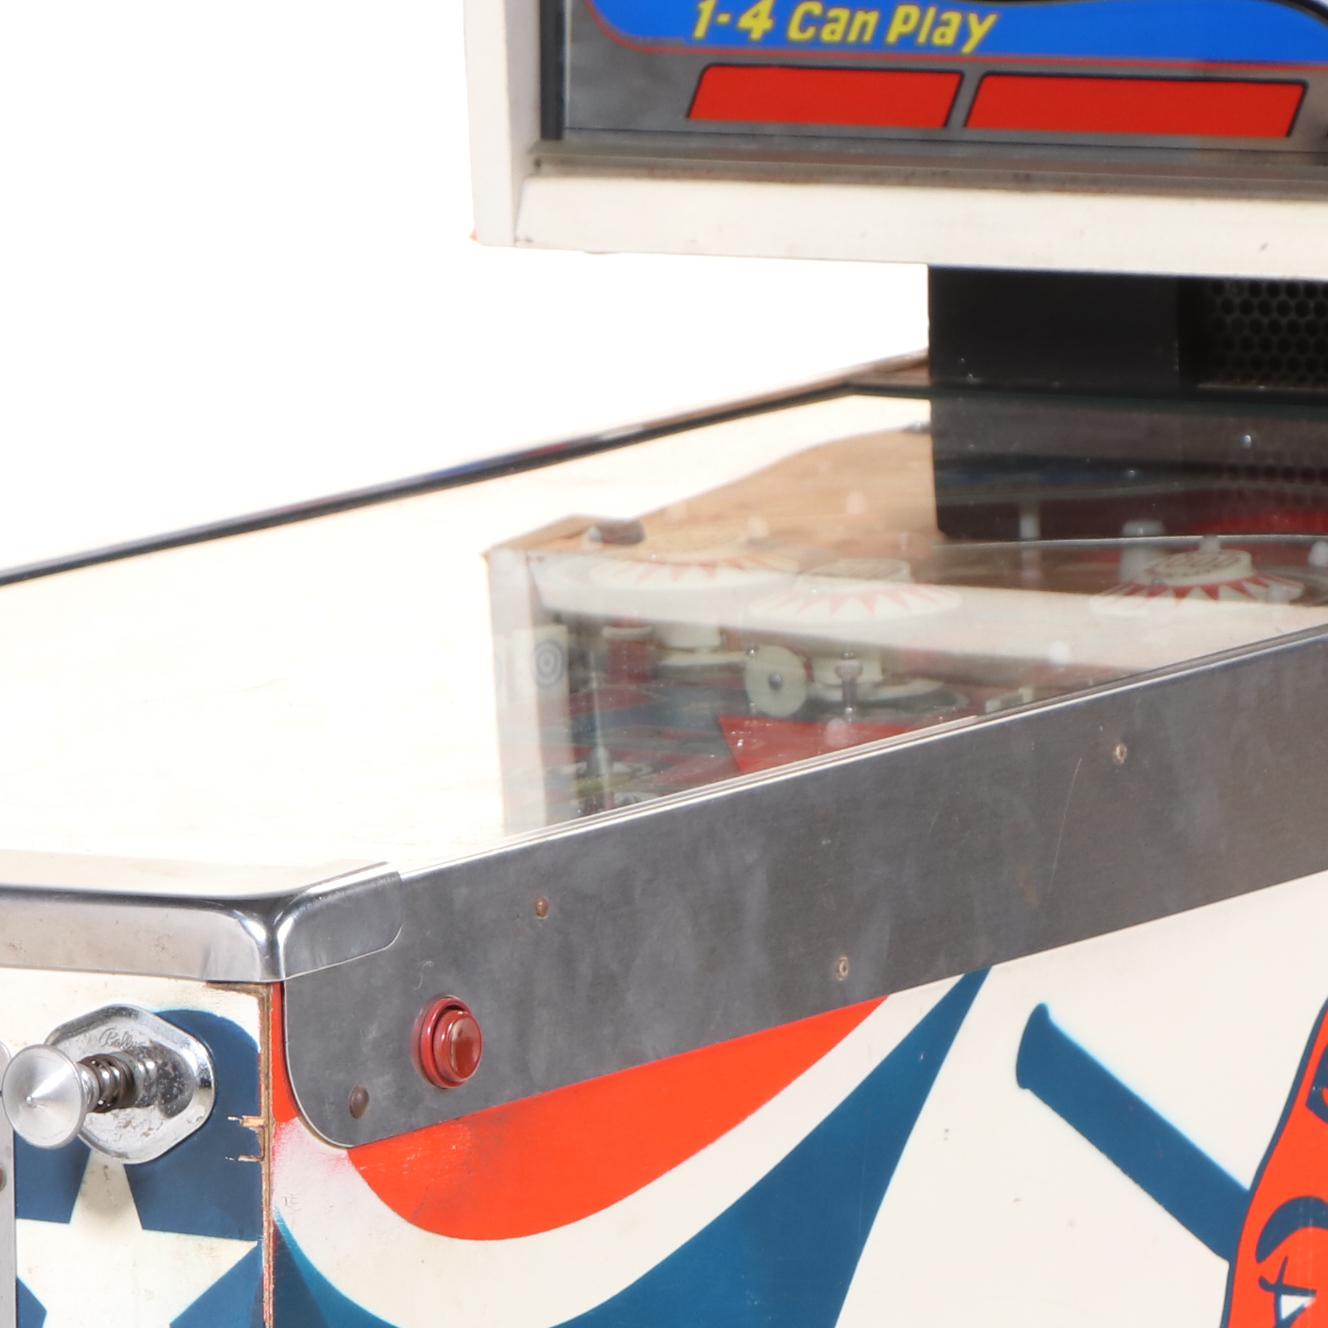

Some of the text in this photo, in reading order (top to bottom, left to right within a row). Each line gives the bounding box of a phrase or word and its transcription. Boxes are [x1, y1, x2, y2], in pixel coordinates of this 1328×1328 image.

[692, 0, 999, 54] 1-4 Can Play
